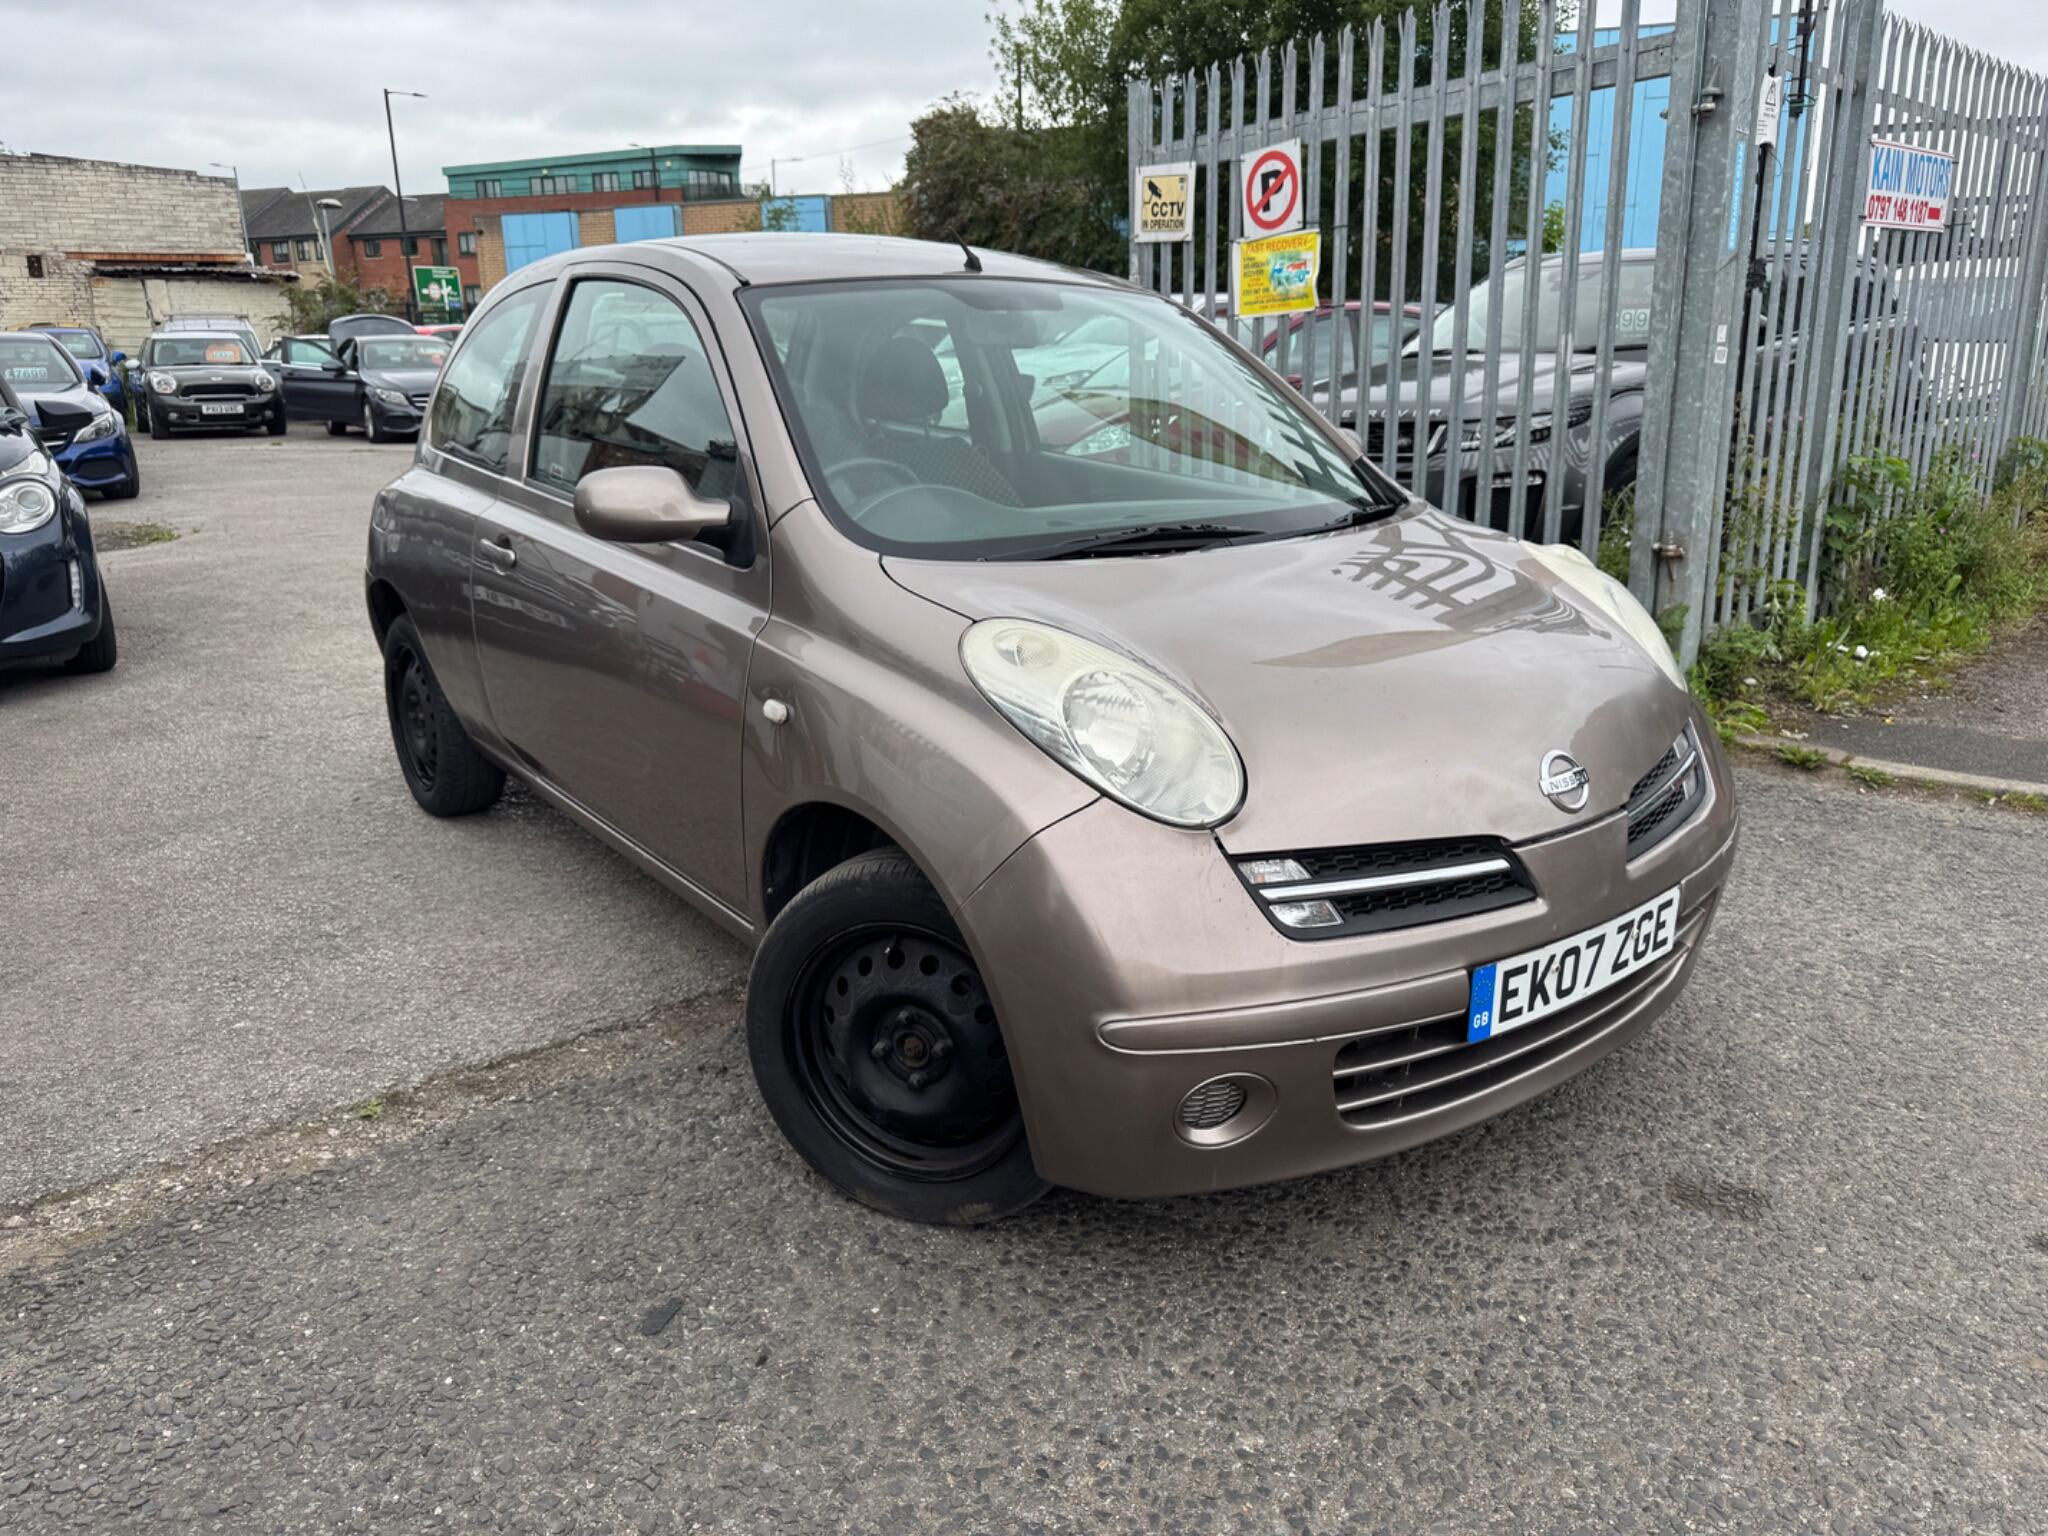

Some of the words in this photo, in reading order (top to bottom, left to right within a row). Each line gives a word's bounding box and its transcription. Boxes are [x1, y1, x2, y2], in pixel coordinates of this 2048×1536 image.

[1905, 152, 1951, 199] MOTORS
[1151, 201, 1184, 217] CCTV
[1868, 195, 1892, 220] 0797
[1142, 220, 1148, 229] IN
[1150, 219, 1184, 229] OPERATION
[1266, 236, 1309, 252] RECOVERY
[1499, 933, 1607, 1024] EK07
[1611, 897, 1674, 975] ZGE
[1474, 1011, 1489, 1028] GB
